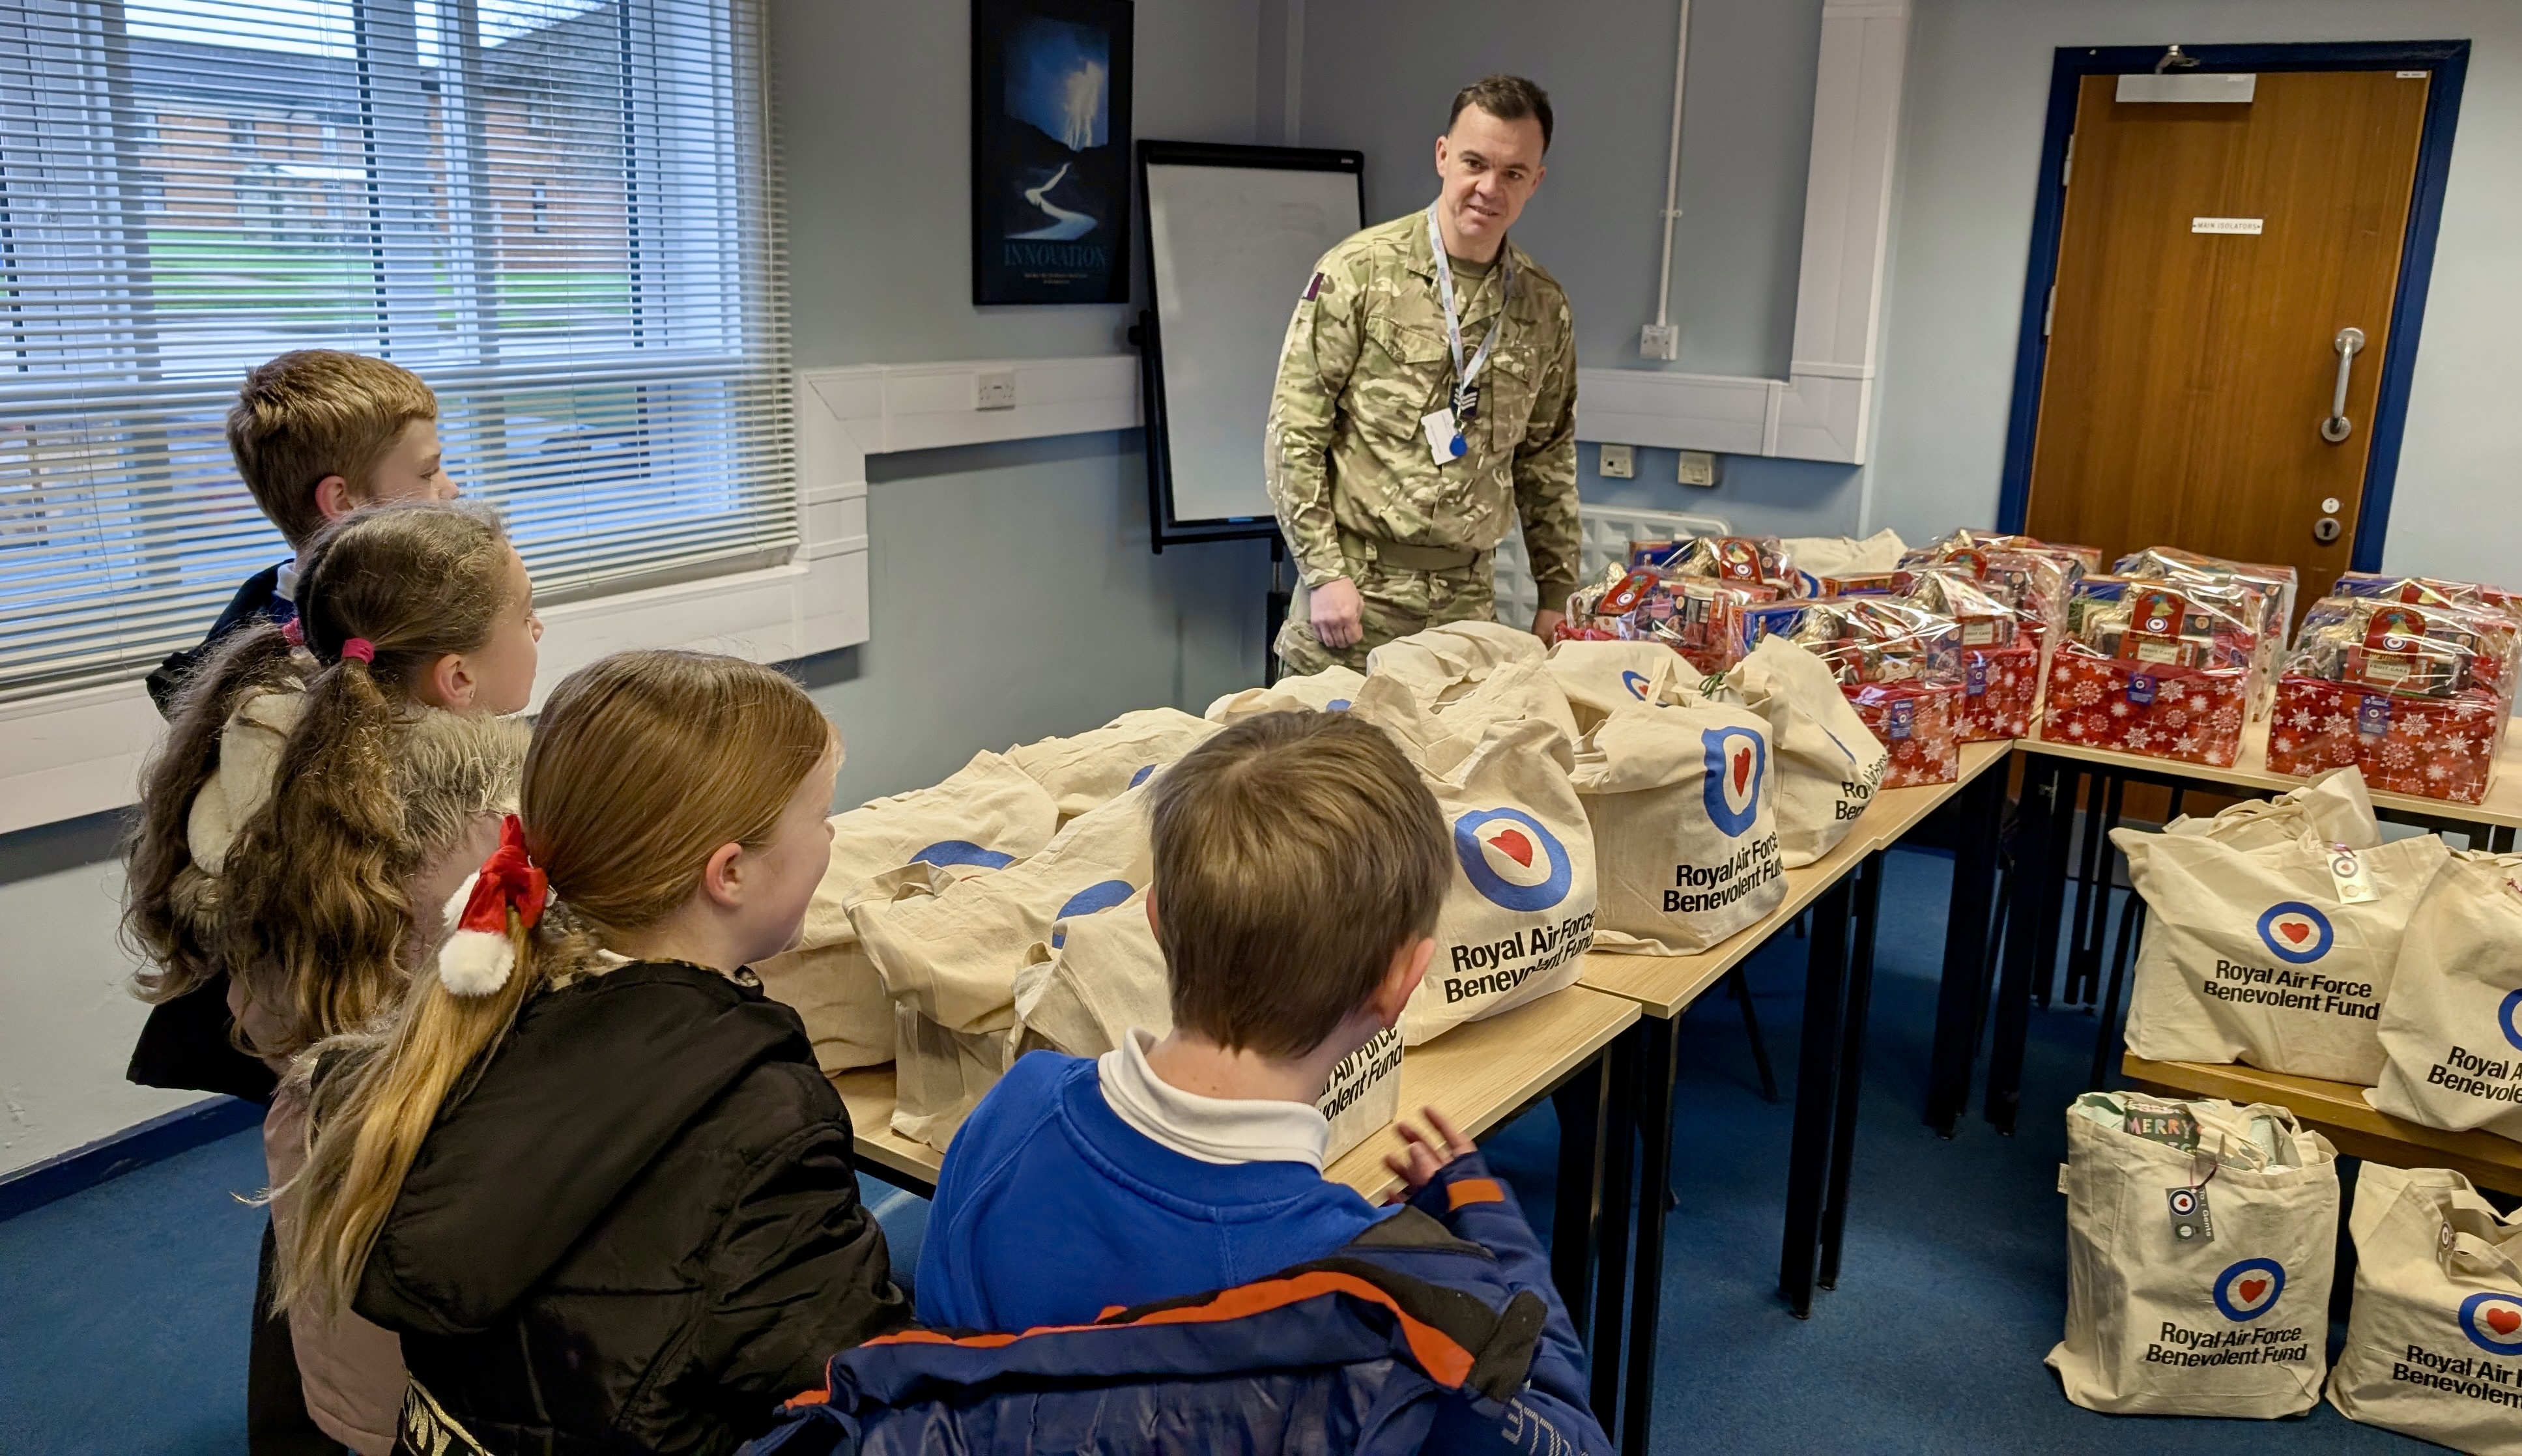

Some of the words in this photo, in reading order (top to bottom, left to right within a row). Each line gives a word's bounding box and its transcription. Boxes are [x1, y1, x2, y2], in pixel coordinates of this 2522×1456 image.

[1004, 244, 1106, 267] INNOVATION
[1676, 857, 1734, 890] Royal
[1734, 848, 1750, 876] Air
[1752, 831, 1778, 864] Force
[1663, 868, 1760, 912] Benevolent
[1451, 931, 1525, 973] Royal
[1531, 926, 1560, 956] Air
[1560, 909, 1595, 943] Force
[2216, 960, 2274, 985] Royal
[2275, 971, 2309, 989] Air
[2310, 975, 2372, 998] Force
[2203, 980, 2321, 1012] Benevolent
[2325, 995, 2381, 1021] Fund
[1368, 1036, 1403, 1090] Fund
[2447, 1046, 2509, 1080] Royal
[2427, 1064, 2522, 1104] Benevole
[2127, 1117, 2195, 1139] MERRY
[2145, 1344, 2259, 1367] Benevolent
[2262, 1344, 2308, 1363] Fund
[2160, 1322, 2221, 1350] Royal
[2222, 1329, 2251, 1348] Air
[2252, 1327, 2302, 1345] Force
[2407, 1345, 2472, 1376] Royal
[2476, 1362, 2513, 1384] Air
[2392, 1362, 2522, 1409] Benevolen
